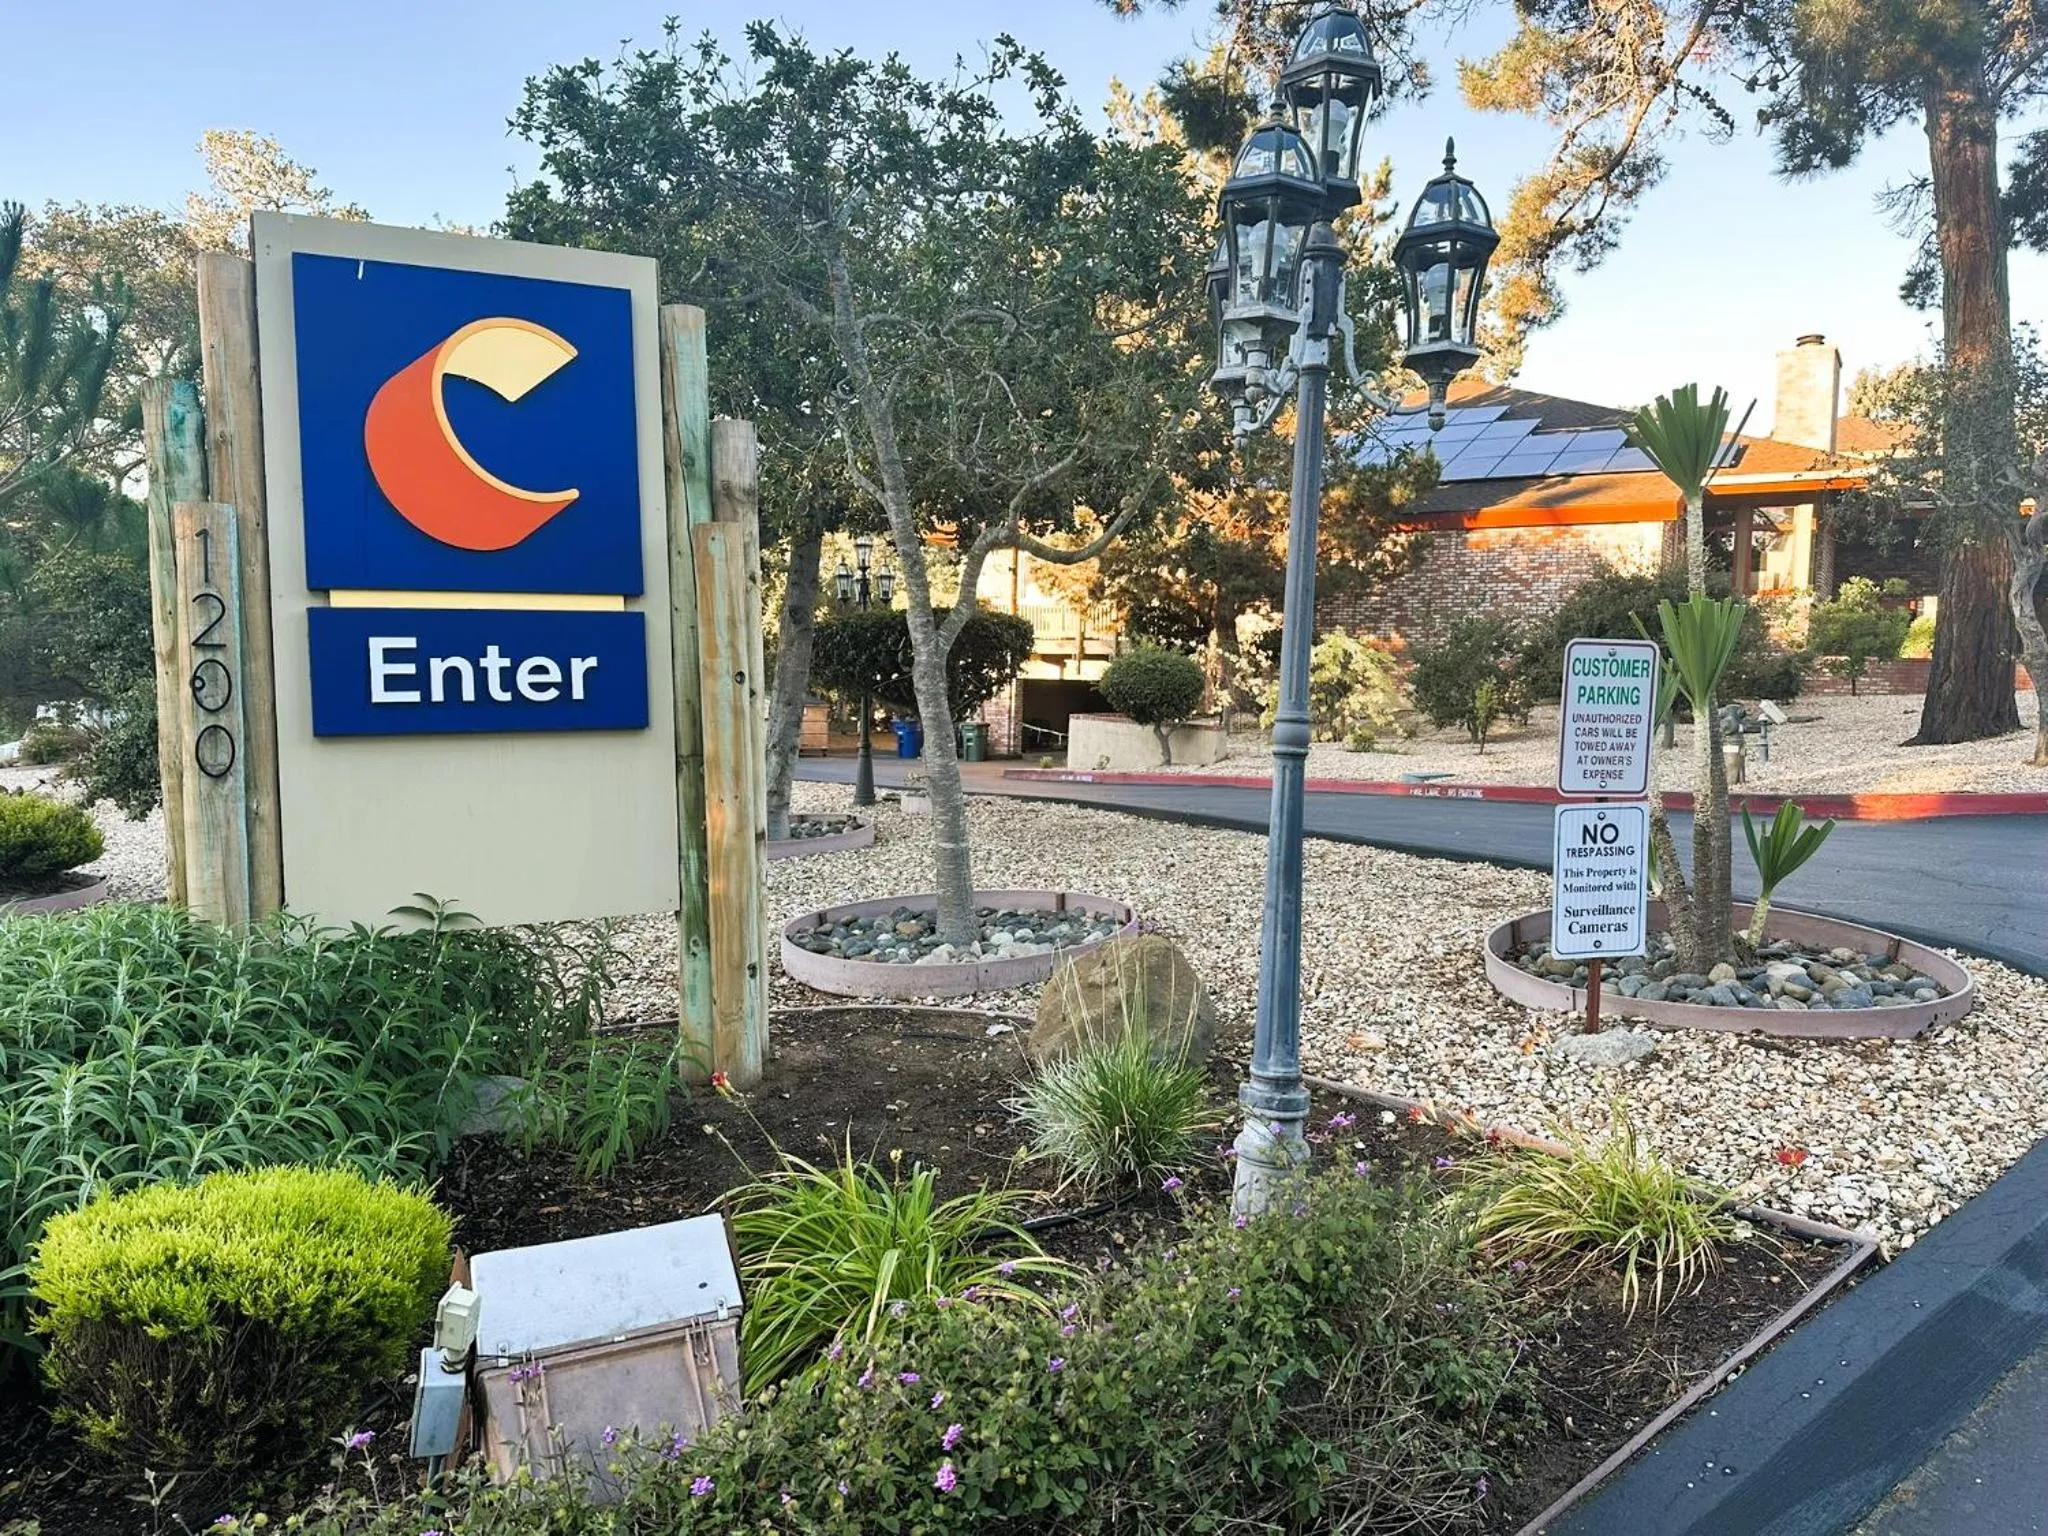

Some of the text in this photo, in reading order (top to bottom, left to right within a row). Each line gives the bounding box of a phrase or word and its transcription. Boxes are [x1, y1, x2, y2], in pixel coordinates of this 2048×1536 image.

[191, 528, 235, 778] 1200
[368, 636, 598, 703] Enter
[1572, 657, 1650, 678] CUSTOMER
[1577, 685, 1640, 706] PARKING
[1572, 713, 1642, 725] UNAUTHORIZED
[1574, 727, 1638, 738] CARS WILL BE
[1575, 741, 1636, 751] TOWED AWAY
[1577, 755, 1632, 766] AT OWNER'S
[1583, 769, 1624, 780] EXPENSE
[1582, 823, 1619, 845] NO
[1566, 845, 1635, 858] TRESPASSING
[1563, 866, 1637, 879] This Property is
[1563, 881, 1637, 893] Monitored with
[1564, 904, 1636, 918] Surveillance
[1568, 921, 1628, 935] Cameras
